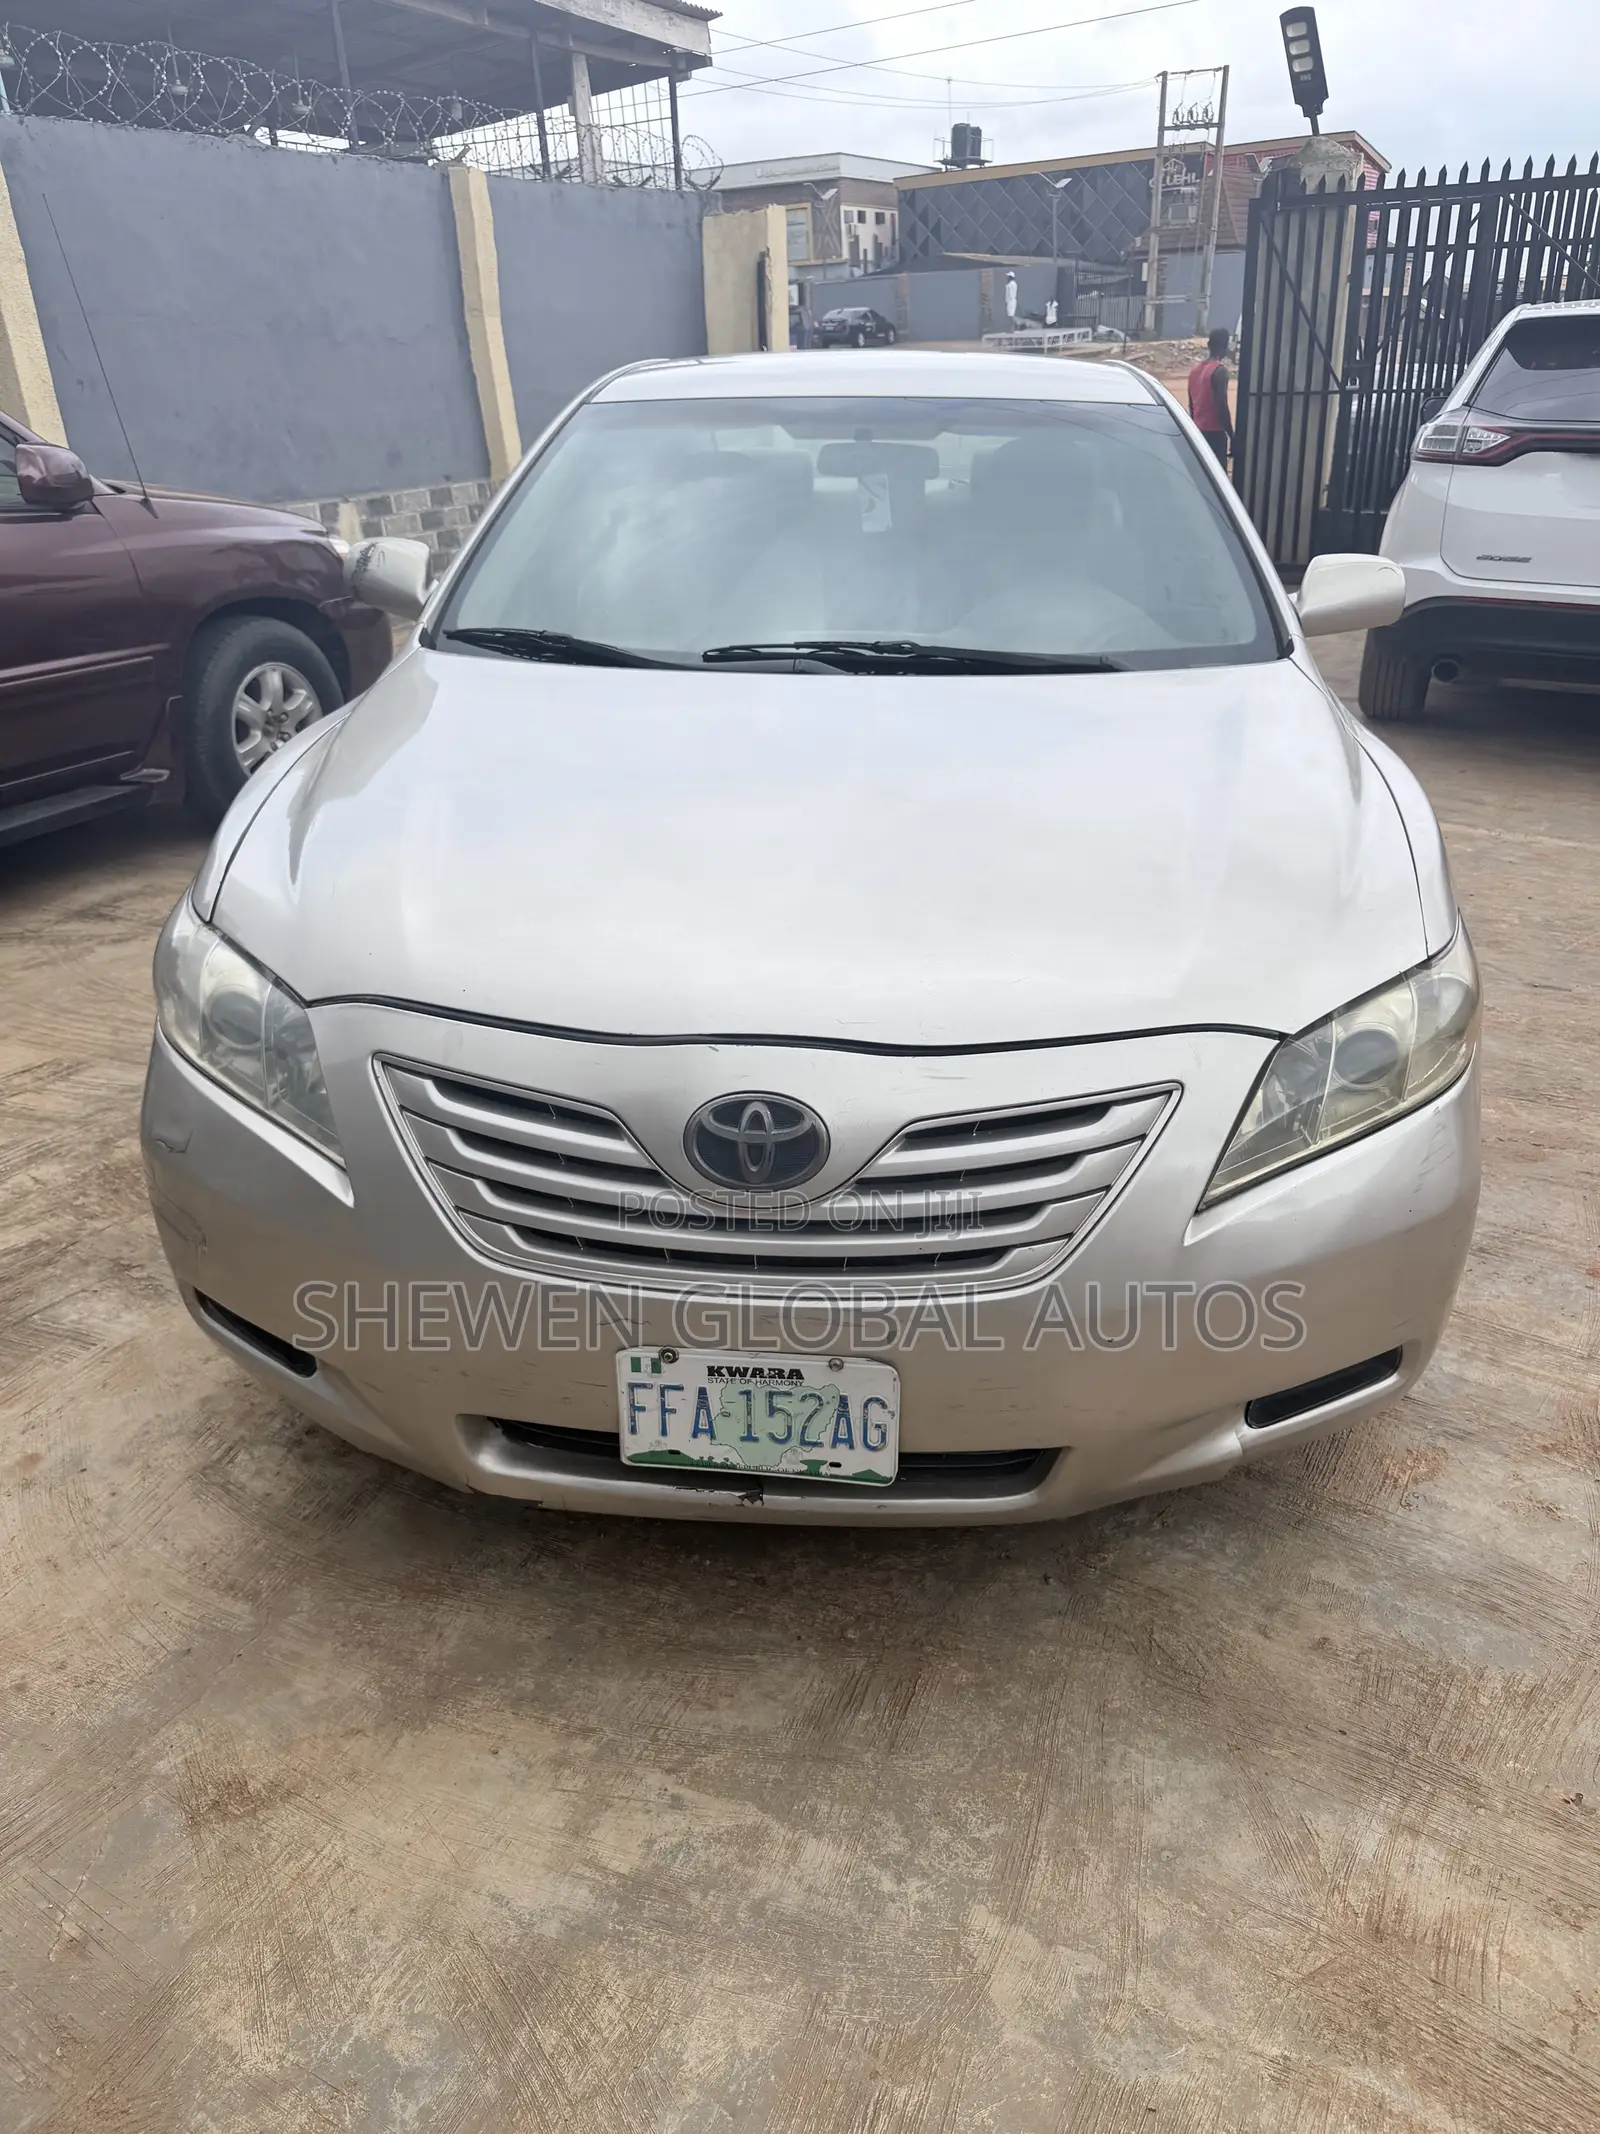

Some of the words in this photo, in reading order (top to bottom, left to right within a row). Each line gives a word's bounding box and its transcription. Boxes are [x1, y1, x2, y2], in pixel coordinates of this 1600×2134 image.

[706, 1365, 805, 1380] KWARA
[707, 1377, 737, 1385] STATE
[756, 1379, 805, 1387] HARMONY
